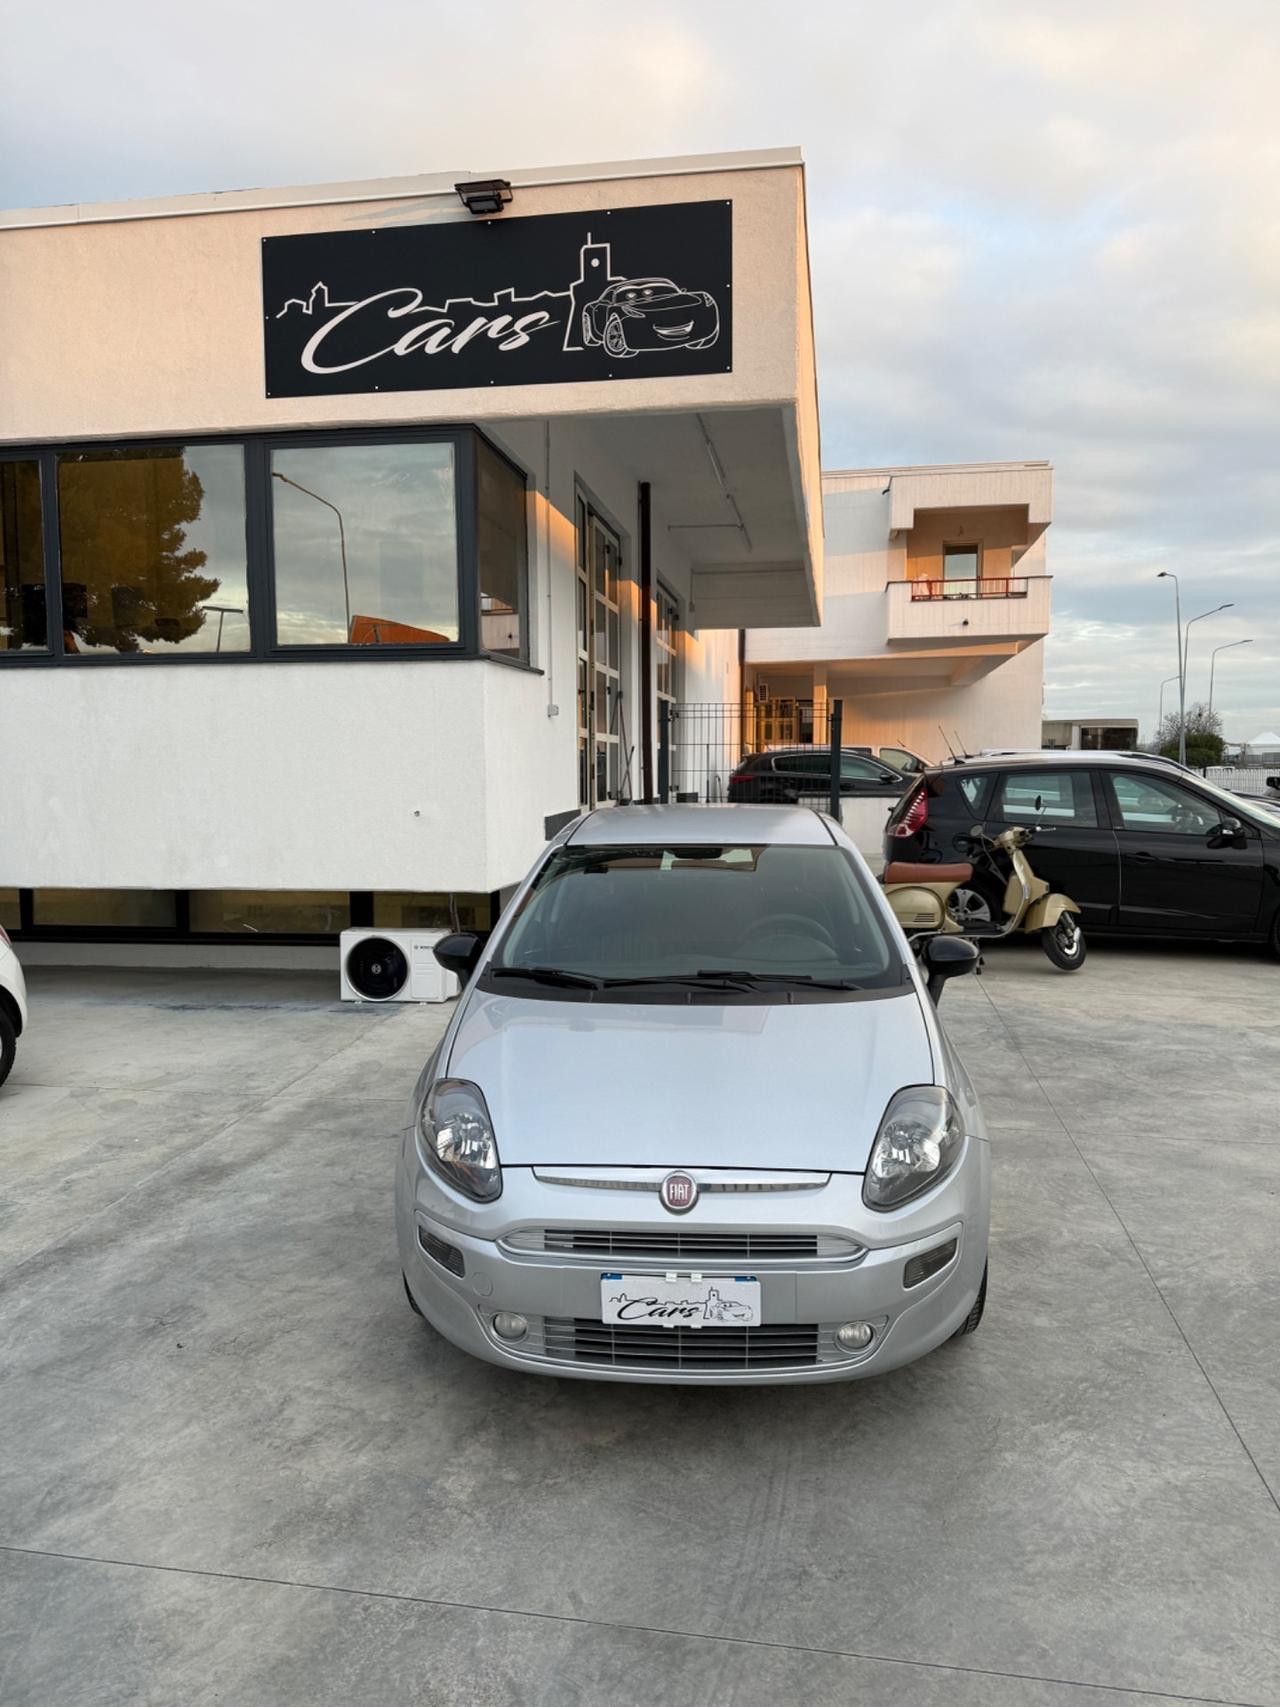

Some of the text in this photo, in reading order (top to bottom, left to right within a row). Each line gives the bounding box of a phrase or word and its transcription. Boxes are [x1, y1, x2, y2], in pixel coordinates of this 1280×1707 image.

[301, 288, 560, 374] Cars
[669, 1183, 690, 1201] FIAT
[617, 1297, 702, 1320] Cars
